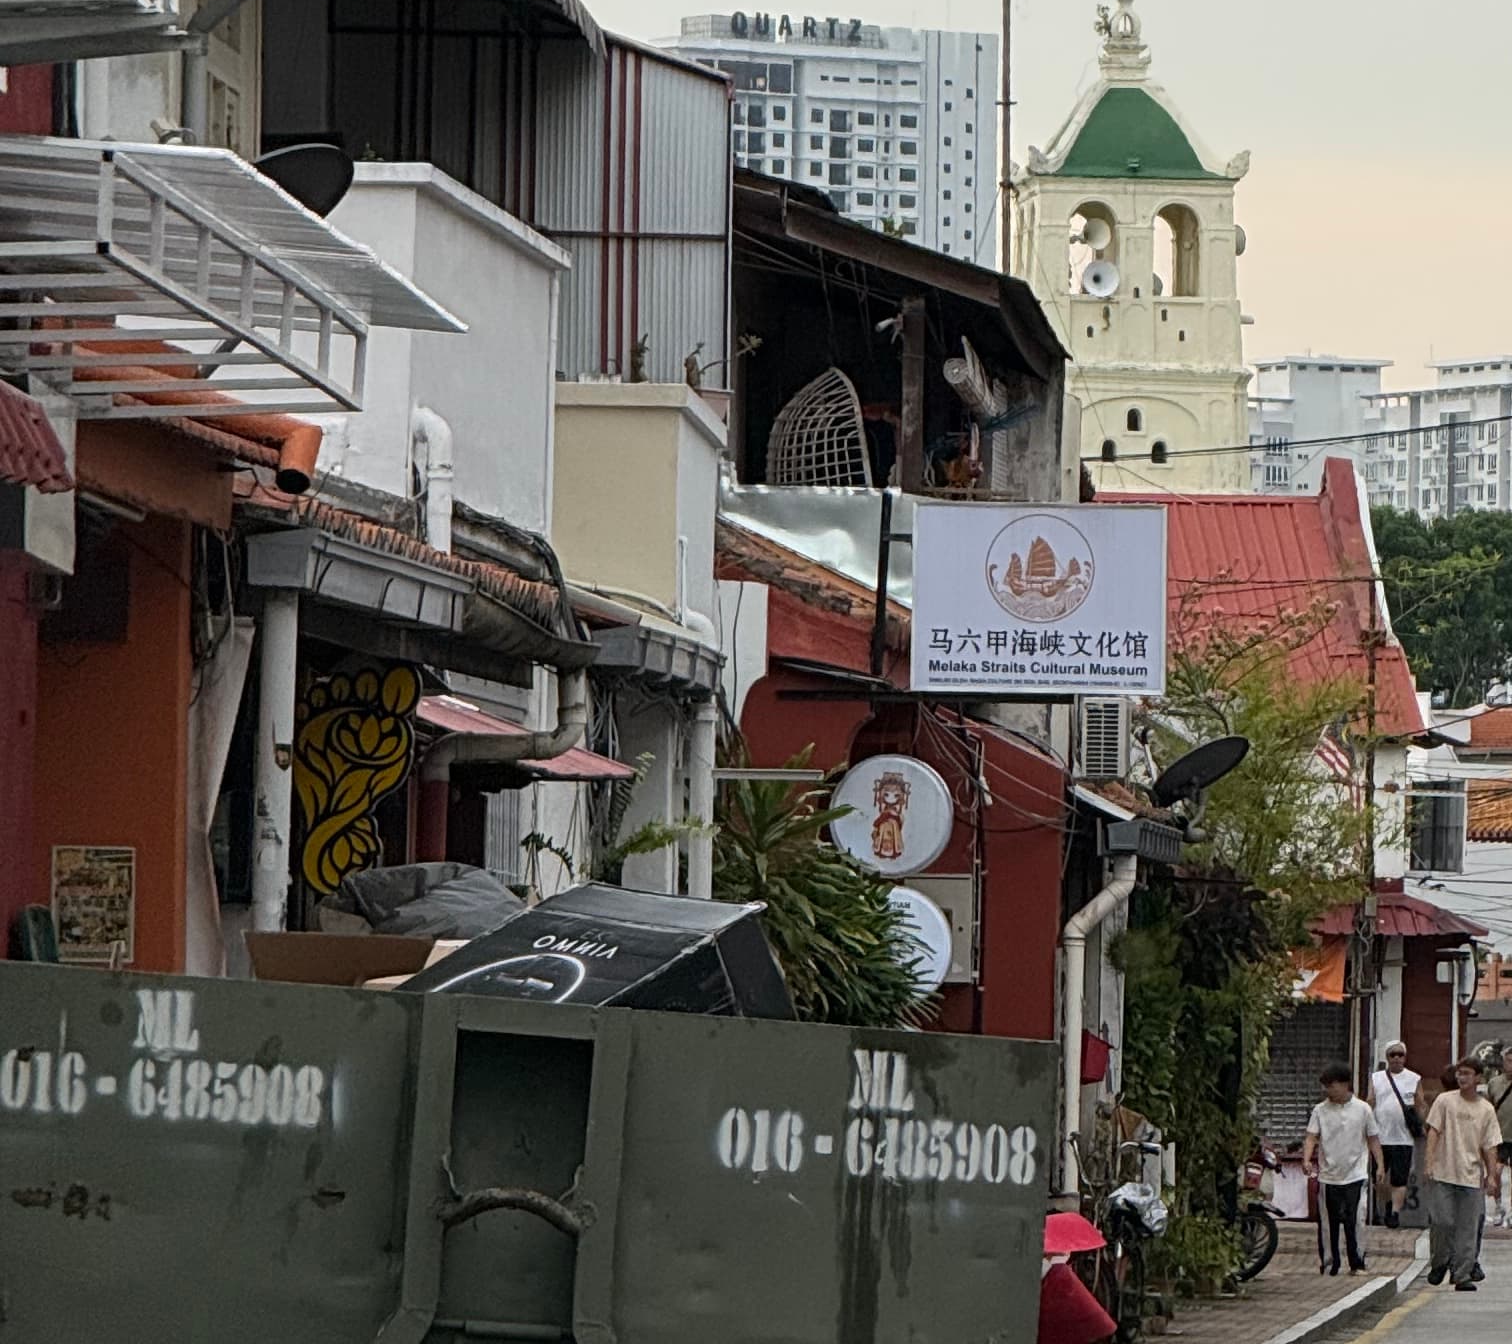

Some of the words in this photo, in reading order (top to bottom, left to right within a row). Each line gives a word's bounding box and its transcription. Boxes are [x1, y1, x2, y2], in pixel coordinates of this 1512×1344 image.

[731, 11, 862, 43] QUARTZ
[929, 628, 1149, 659] 马六甲海峡文化馆
[929, 660, 976, 673] Melaka
[981, 661, 1026, 674] Straits
[1031, 661, 1085, 676] Cultural
[1089, 663, 1148, 677] Museum
